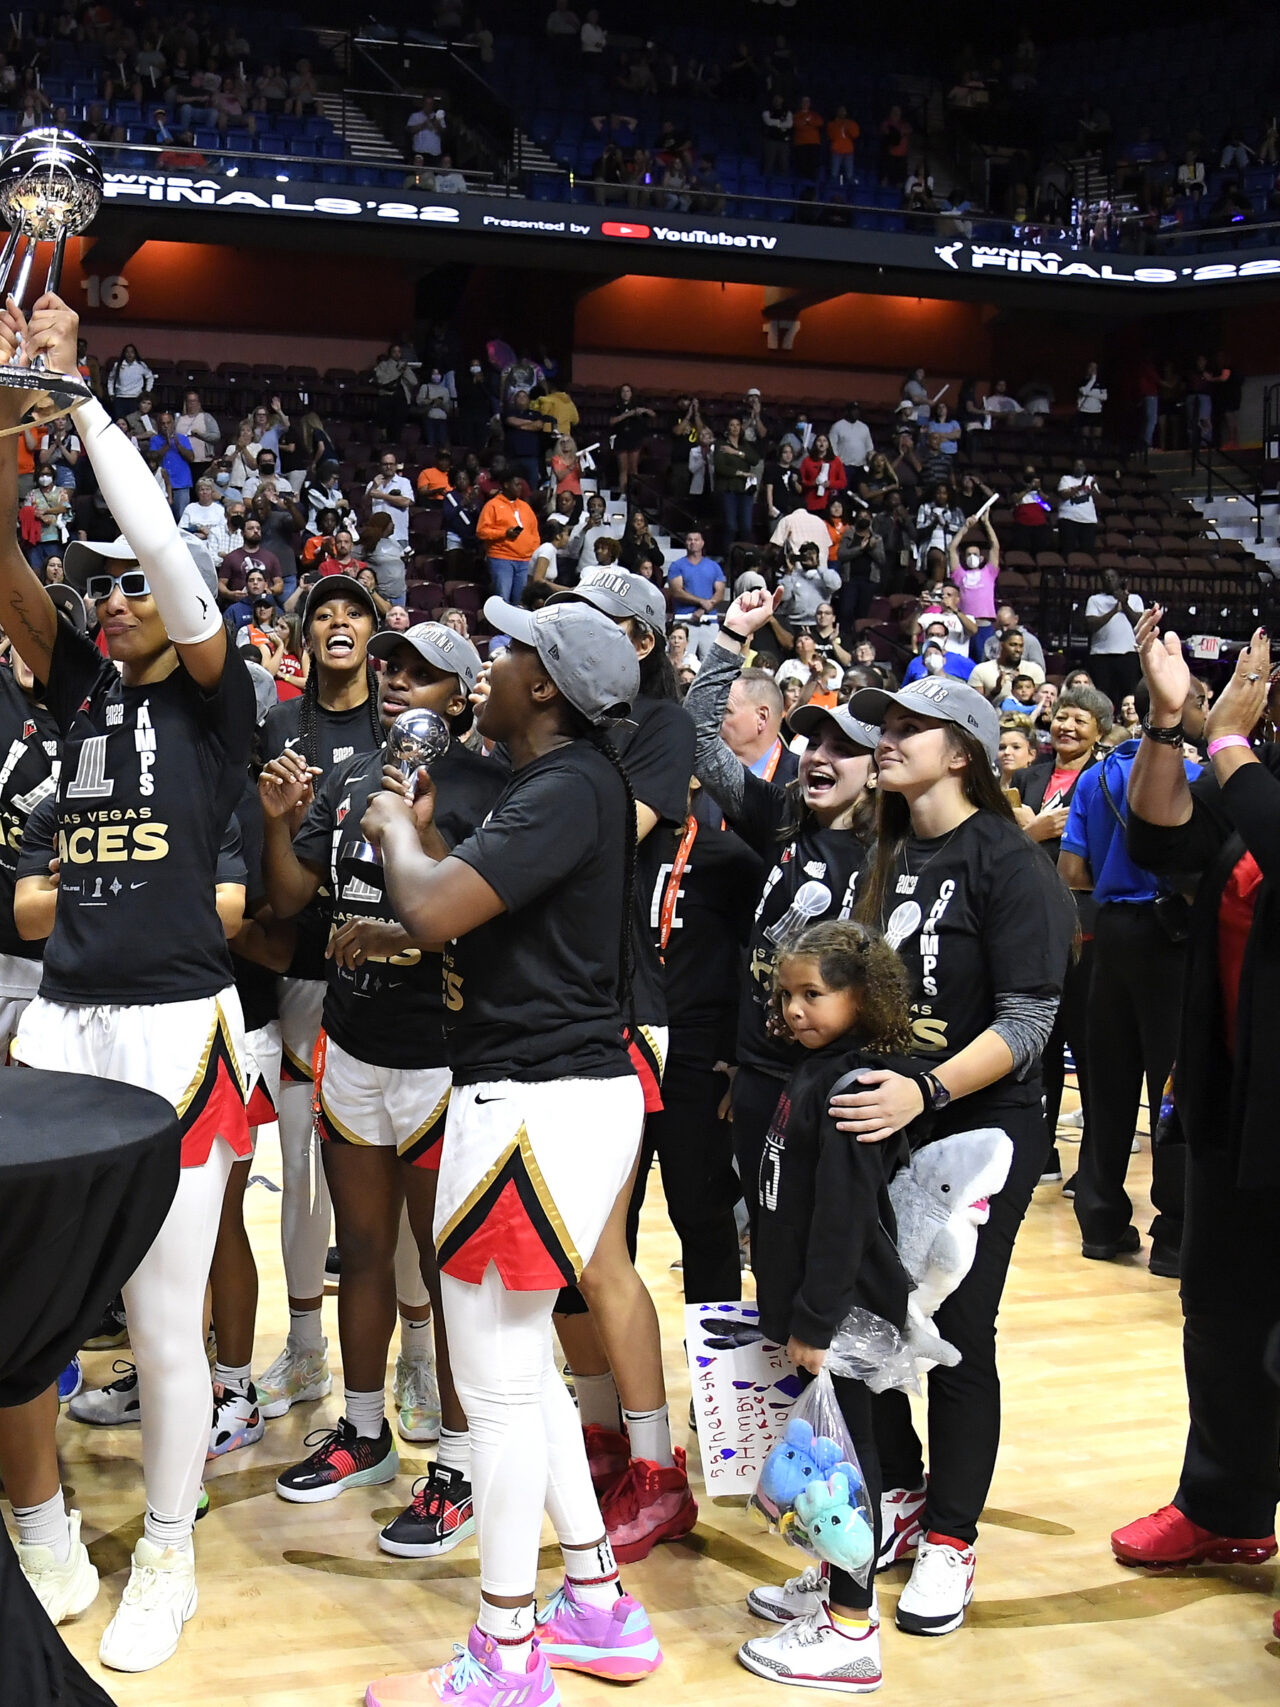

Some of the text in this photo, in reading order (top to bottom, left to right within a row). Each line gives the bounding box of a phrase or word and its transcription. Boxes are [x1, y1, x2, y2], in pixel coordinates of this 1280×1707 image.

[102, 173, 220, 190] WNBA
[483, 216, 590, 234] Presented by
[971, 246, 1062, 261] WNBA
[81, 275, 129, 309] 16
[761, 321, 800, 350] 17
[1201, 638, 1217, 651] EXIT
[105, 702, 124, 727] 2022
[134, 699, 157, 797] AMPS
[333, 746, 354, 764] 2022
[87, 807, 152, 824] VEGAS
[58, 822, 170, 864] ACES
[919, 878, 956, 997] CHAMPS
